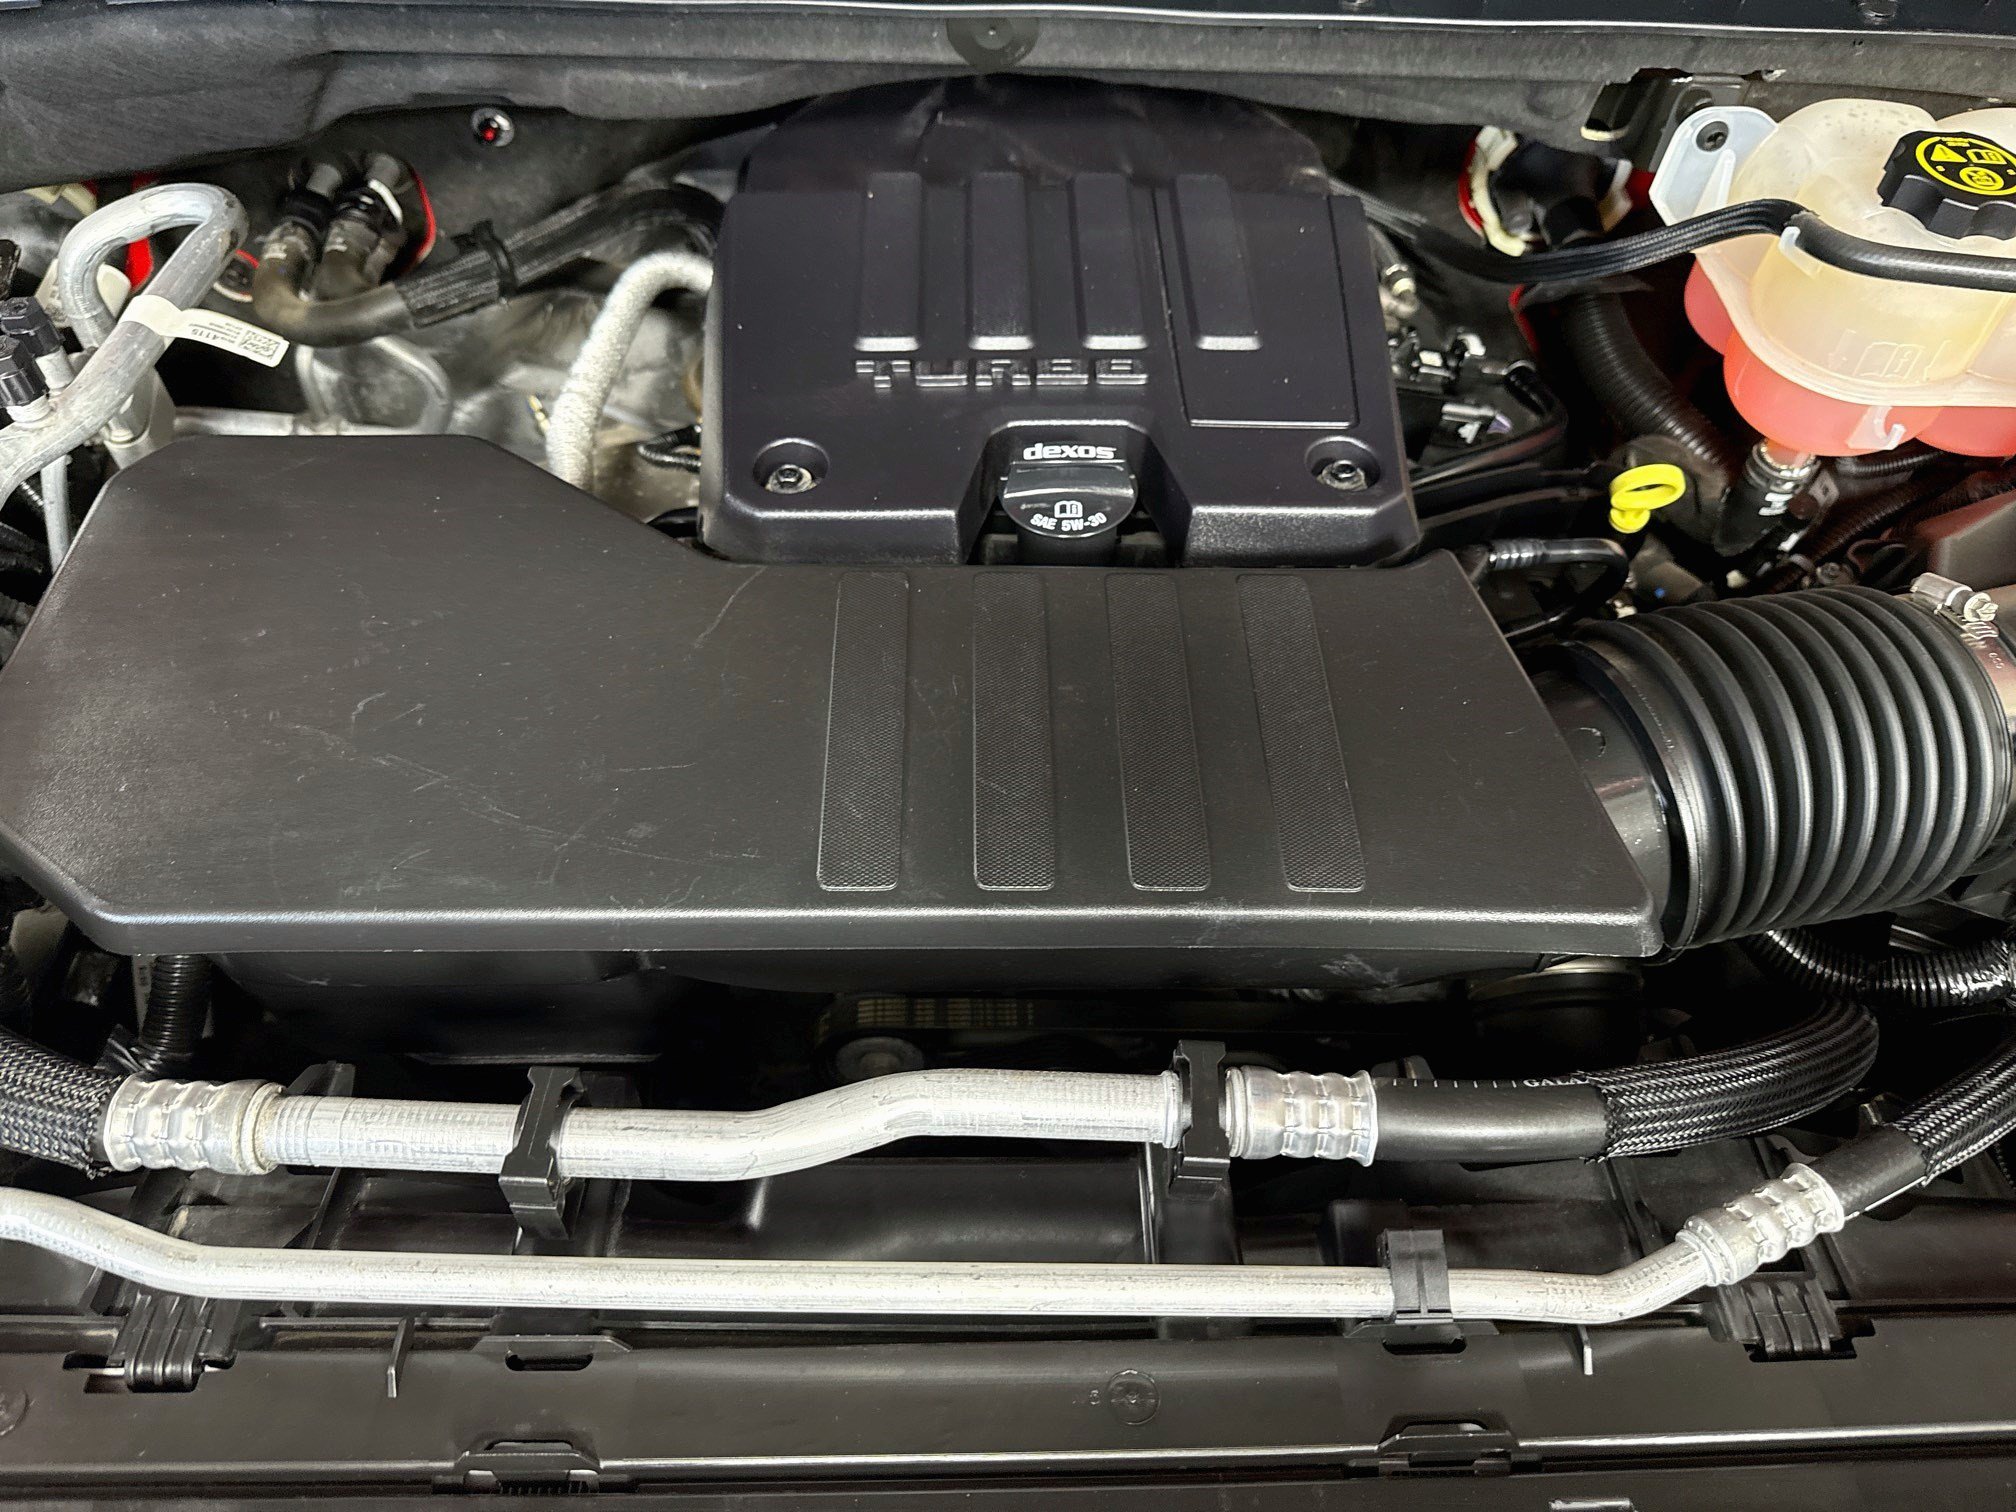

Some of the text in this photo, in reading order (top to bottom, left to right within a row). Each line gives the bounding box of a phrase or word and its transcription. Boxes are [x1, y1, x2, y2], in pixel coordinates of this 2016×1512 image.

[1023, 442, 1117, 460] dexos
[1030, 512, 1107, 531] SAE 5W-30
